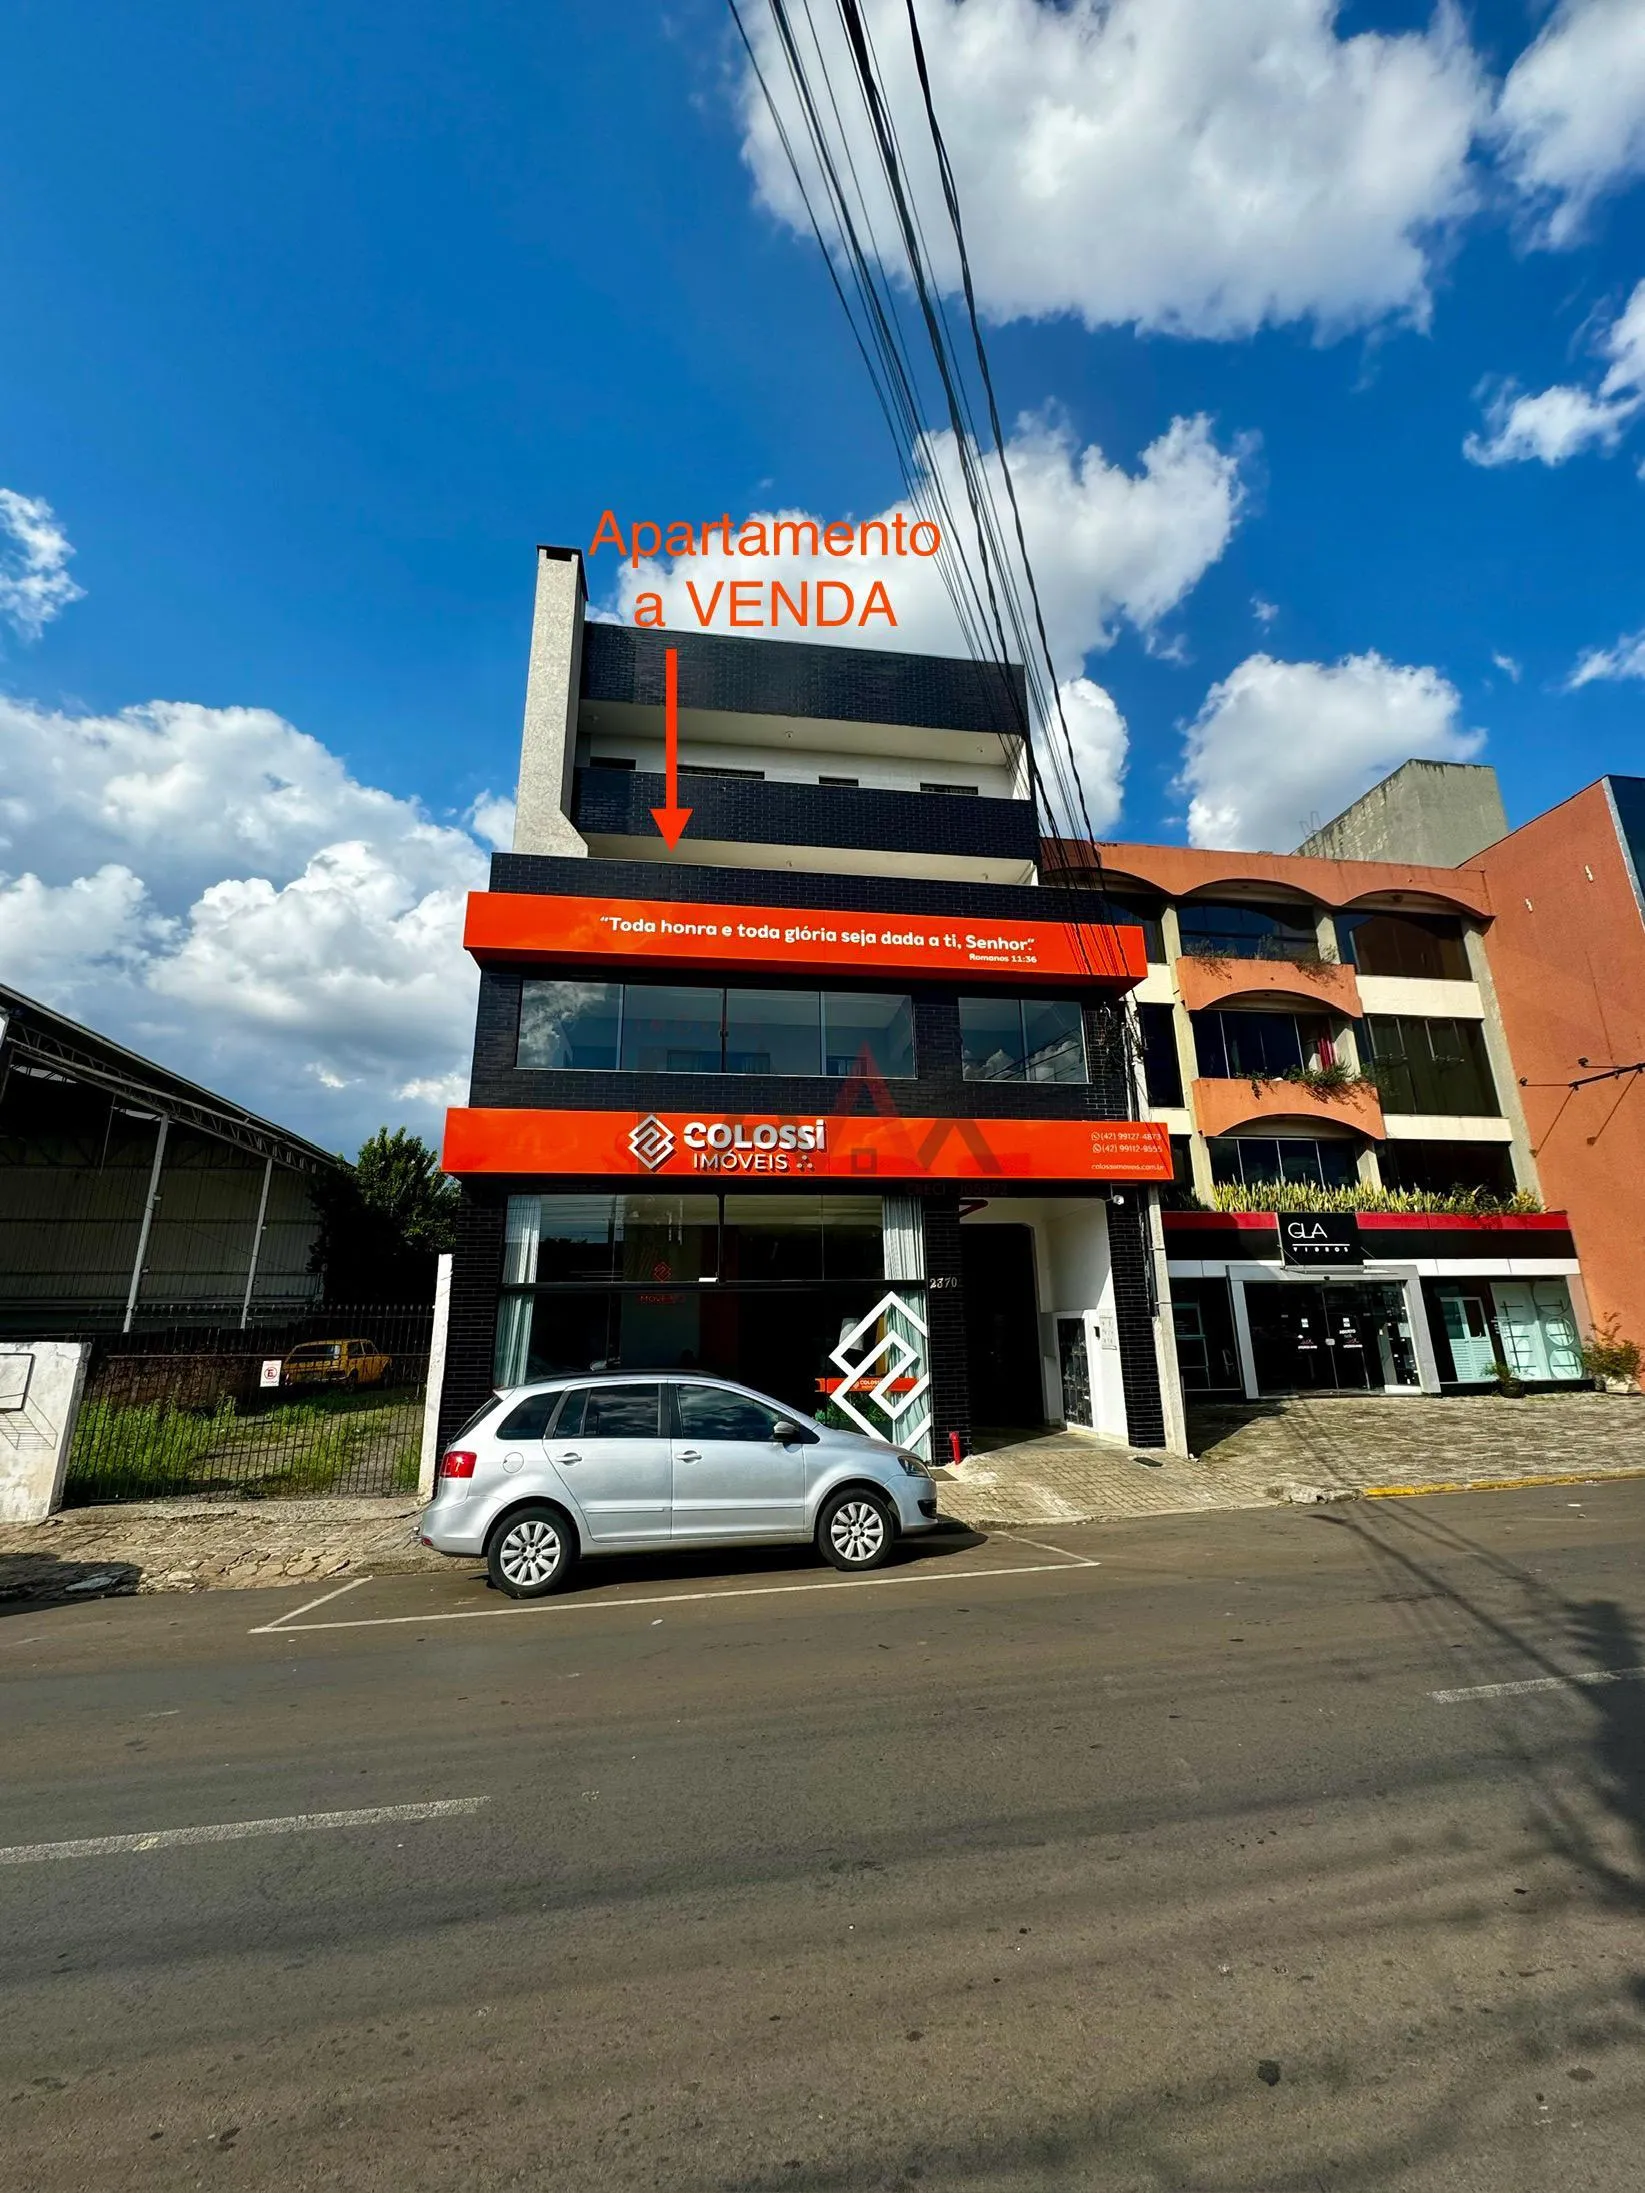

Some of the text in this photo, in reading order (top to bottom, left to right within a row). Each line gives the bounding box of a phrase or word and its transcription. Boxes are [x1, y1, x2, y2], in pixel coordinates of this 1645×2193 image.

[661, 919, 717, 936] honra
[721, 926, 733, 937] e
[737, 923, 780, 940] toda
[784, 925, 837, 943] glória
[841, 929, 877, 946] seja
[881, 931, 925, 947] dada
[928, 936, 940, 947] a
[943, 934, 962, 949] ti,
[968, 953, 1038, 964] Romanos 11:36
[692, 1150, 788, 1170] IMÓVEIS
[1287, 1222, 1328, 1239] GLA
